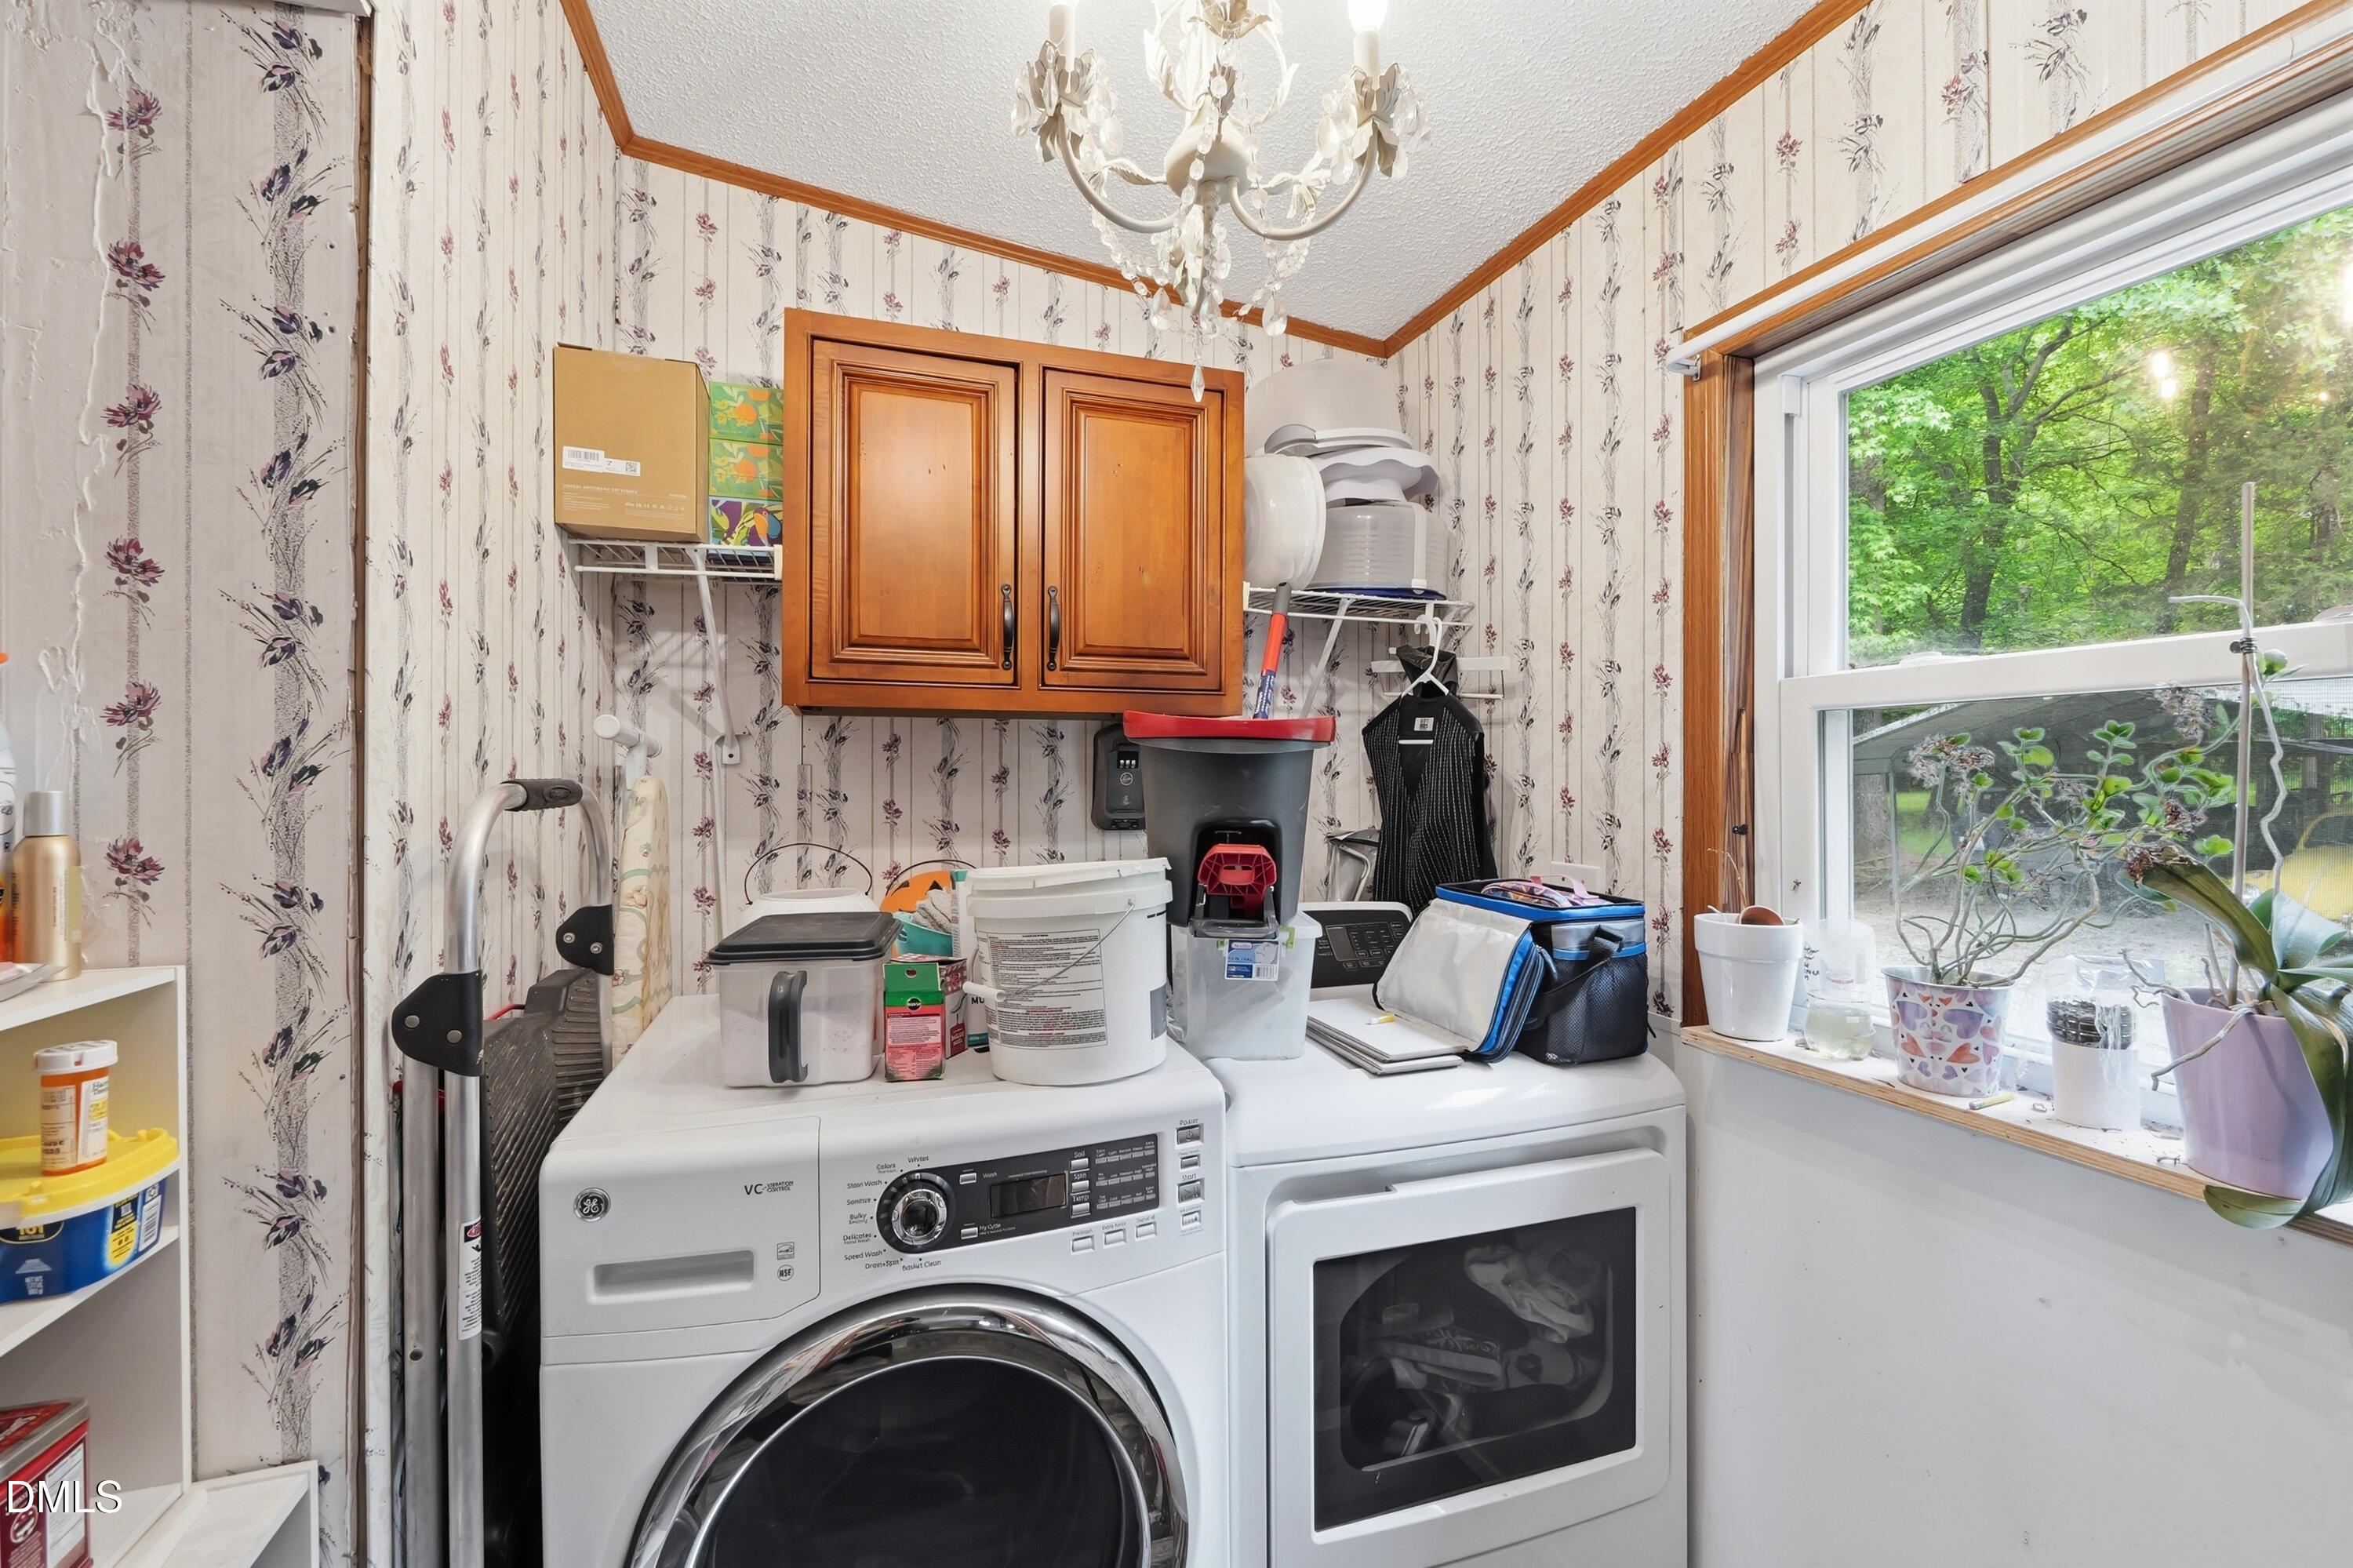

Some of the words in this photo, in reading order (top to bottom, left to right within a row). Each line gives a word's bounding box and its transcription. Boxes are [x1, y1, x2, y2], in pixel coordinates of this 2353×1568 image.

[744, 1183, 763, 1195] VC
[842, 1232, 871, 1241] Delicates
[844, 1253, 864, 1261] Speed
[902, 1262, 923, 1271] Basket
